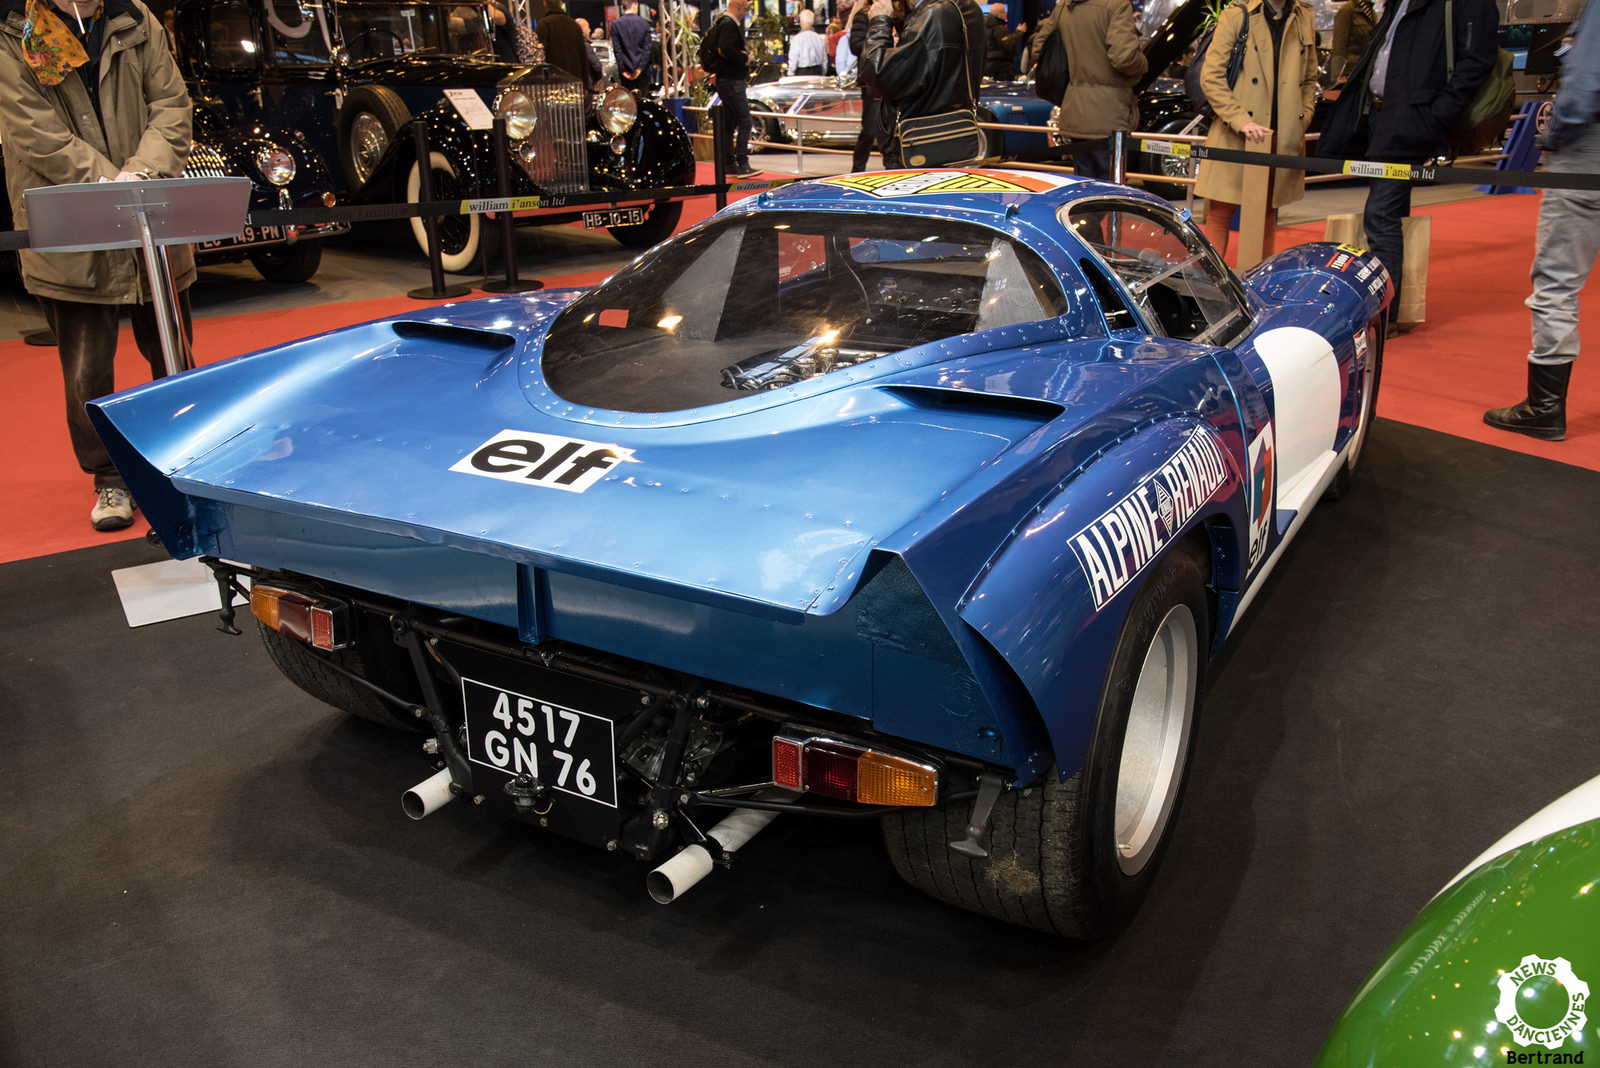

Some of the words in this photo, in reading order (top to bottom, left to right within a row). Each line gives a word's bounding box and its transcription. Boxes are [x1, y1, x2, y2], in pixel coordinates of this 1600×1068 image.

[1146, 142, 1171, 153] william
[1198, 148, 1209, 157] ltd
[1350, 164, 1383, 176] william
[1385, 166, 1419, 179] i'anson
[1422, 168, 1435, 179] ltd
[469, 199, 509, 212] william
[512, 197, 549, 210] i'anson
[552, 196, 566, 206] ltd
[586, 210, 640, 227] HB-10-15
[470, 439, 619, 485] elf
[1076, 486, 1163, 606] ALPINE
[1161, 428, 1225, 529] RENAULT
[1248, 520, 1268, 570] elf
[492, 692, 580, 748] 4517
[484, 730, 539, 779] GN
[552, 749, 597, 796] 76
